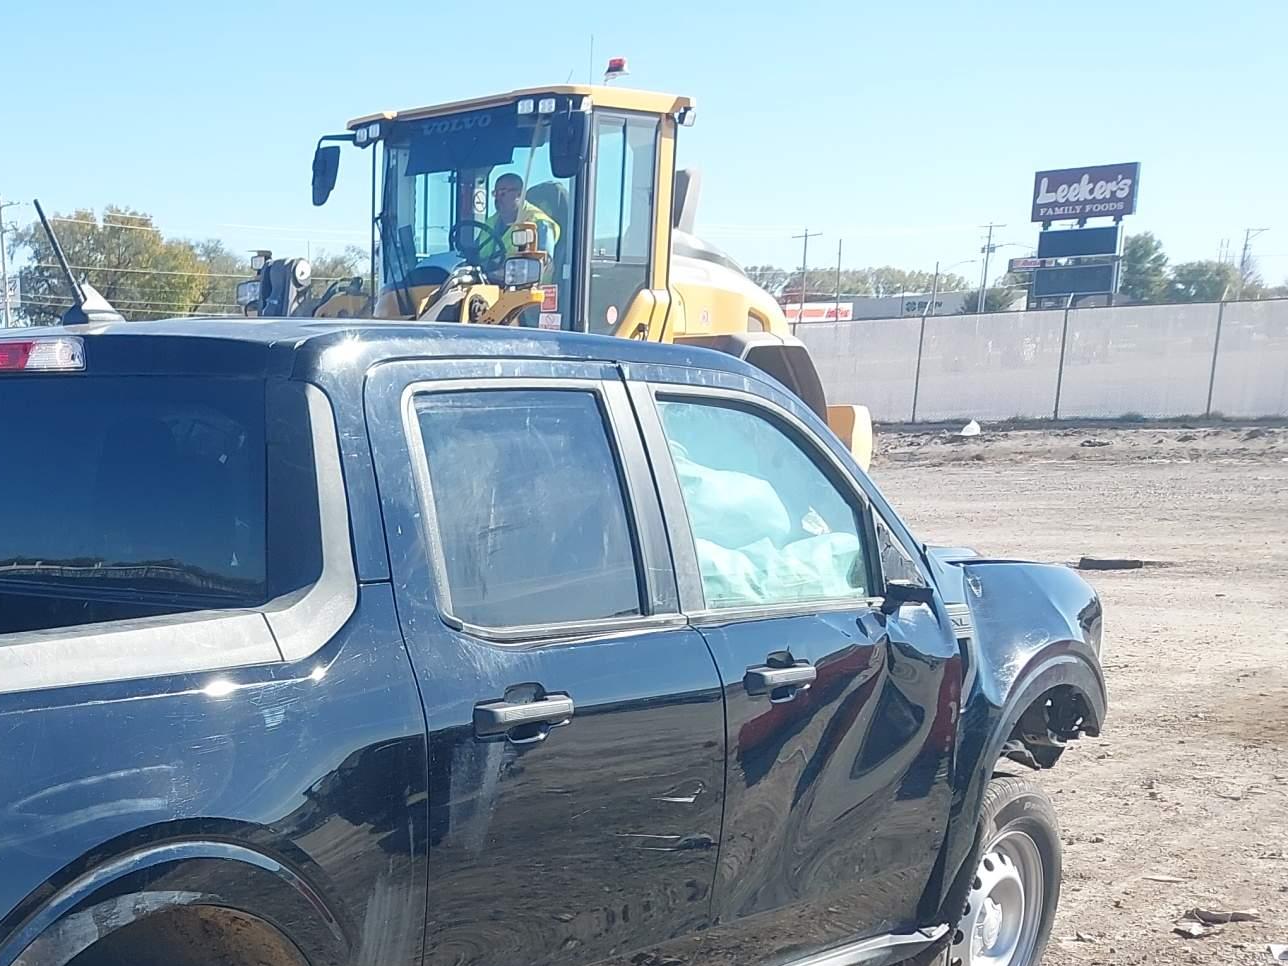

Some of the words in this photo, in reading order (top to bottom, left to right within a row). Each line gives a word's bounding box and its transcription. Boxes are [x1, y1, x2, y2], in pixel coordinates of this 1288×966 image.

[421, 114, 492, 136] VOLVO
[1036, 174, 1132, 204] Leeker's
[1039, 205, 1083, 216] FAMILY
[1085, 202, 1125, 213] FOODS
